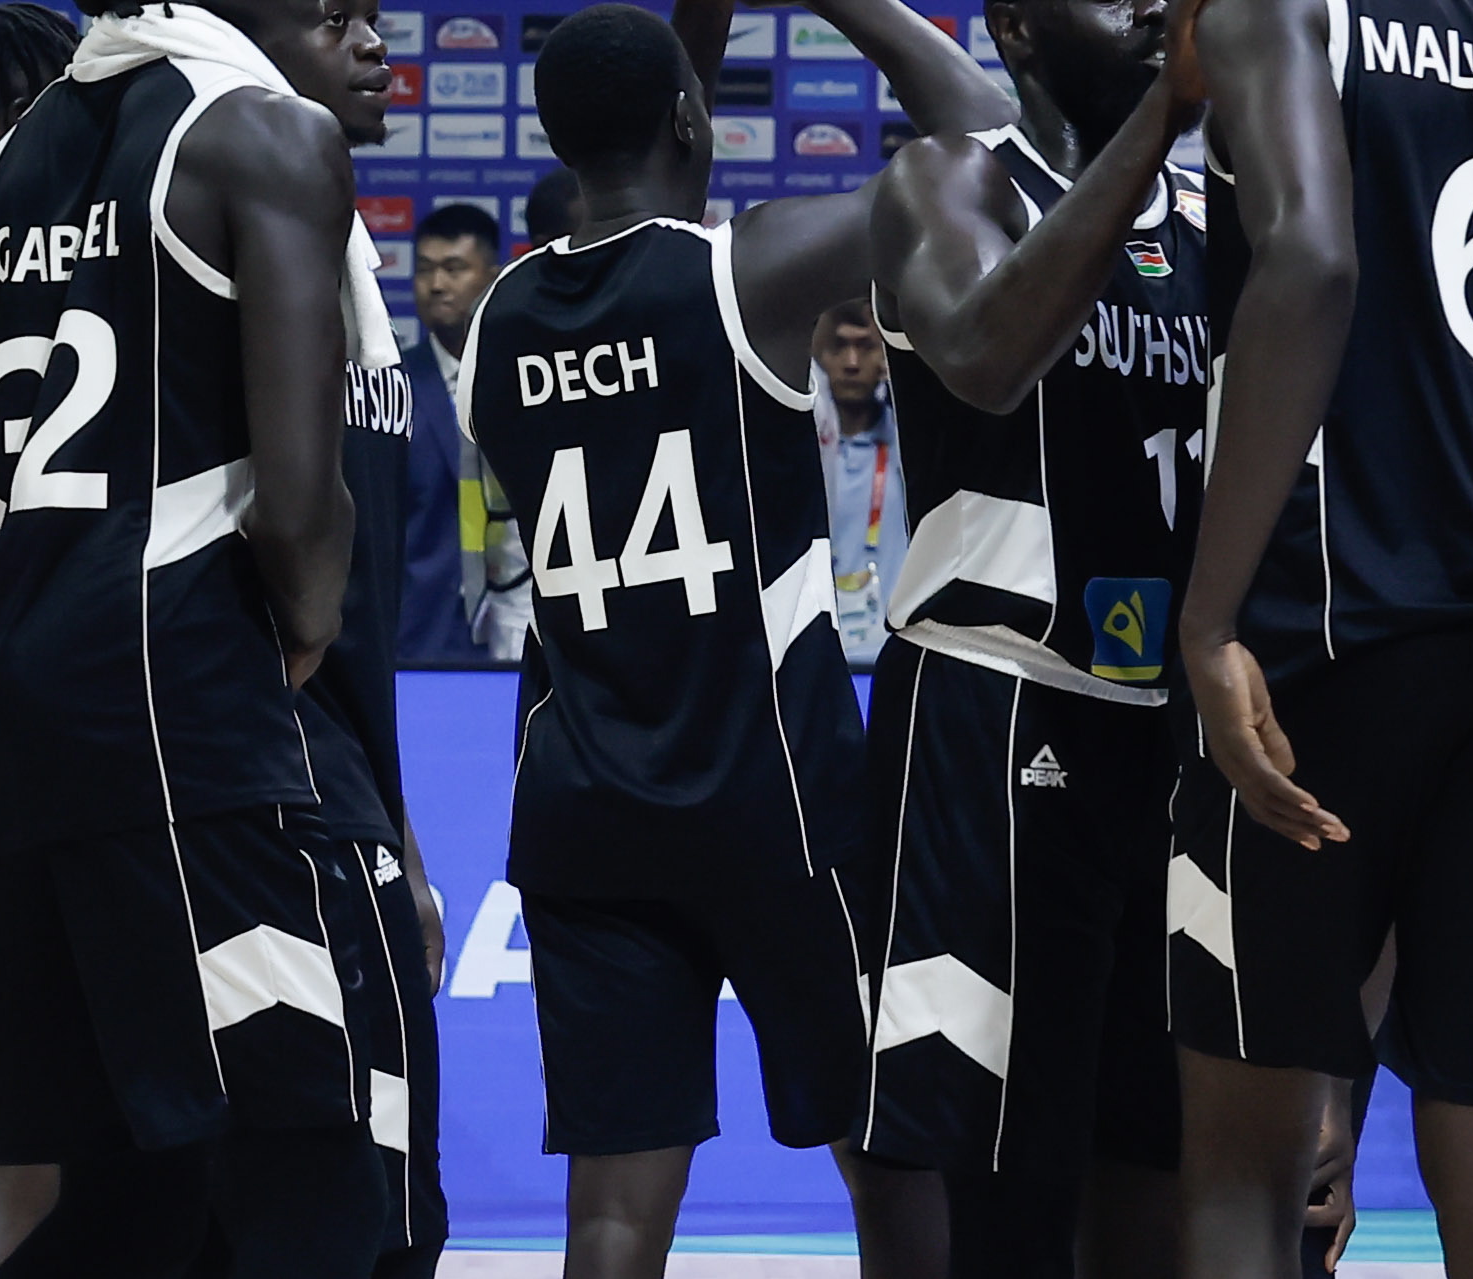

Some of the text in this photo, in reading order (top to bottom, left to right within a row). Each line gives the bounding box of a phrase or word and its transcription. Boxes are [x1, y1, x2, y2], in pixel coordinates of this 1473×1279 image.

[517, 336, 659, 407] DECH
[532, 429, 734, 632] 44
[1021, 769, 1068, 788] PEAK
[374, 859, 403, 887] PEAK
